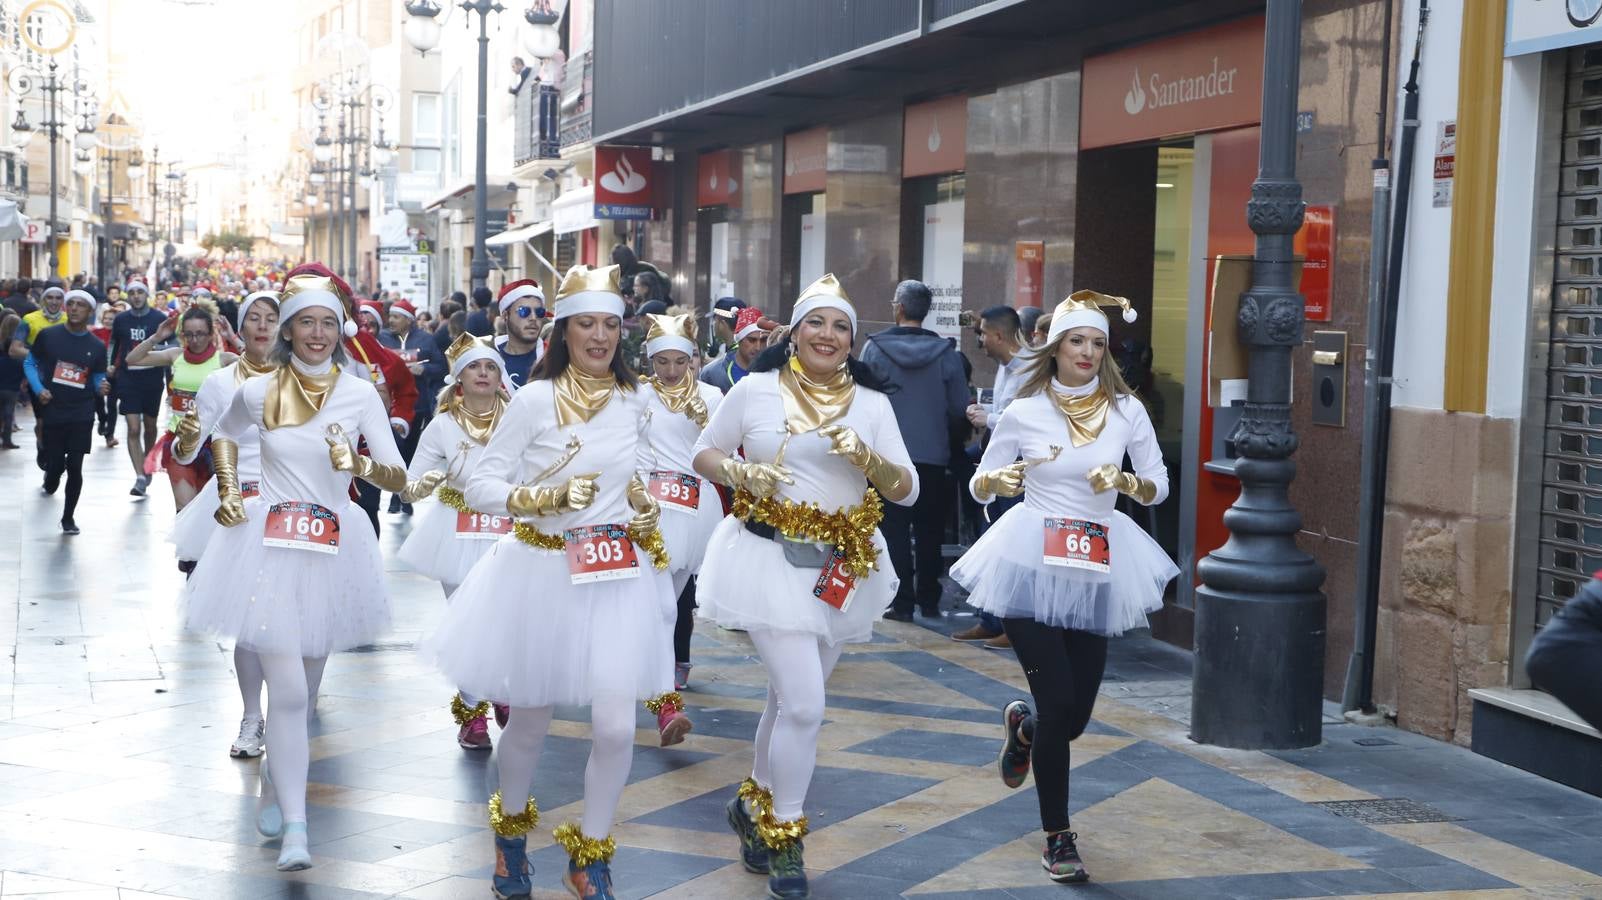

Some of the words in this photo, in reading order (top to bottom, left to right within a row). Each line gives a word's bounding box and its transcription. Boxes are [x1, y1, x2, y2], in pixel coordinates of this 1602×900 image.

[1148, 55, 1238, 110] Santander
[130, 328, 146, 340] HO
[60, 368, 80, 381] 294
[660, 482, 689, 501] 593
[284, 515, 325, 537] 160
[470, 513, 502, 529] 196
[583, 540, 624, 565] 303
[1066, 533, 1091, 554] 66
